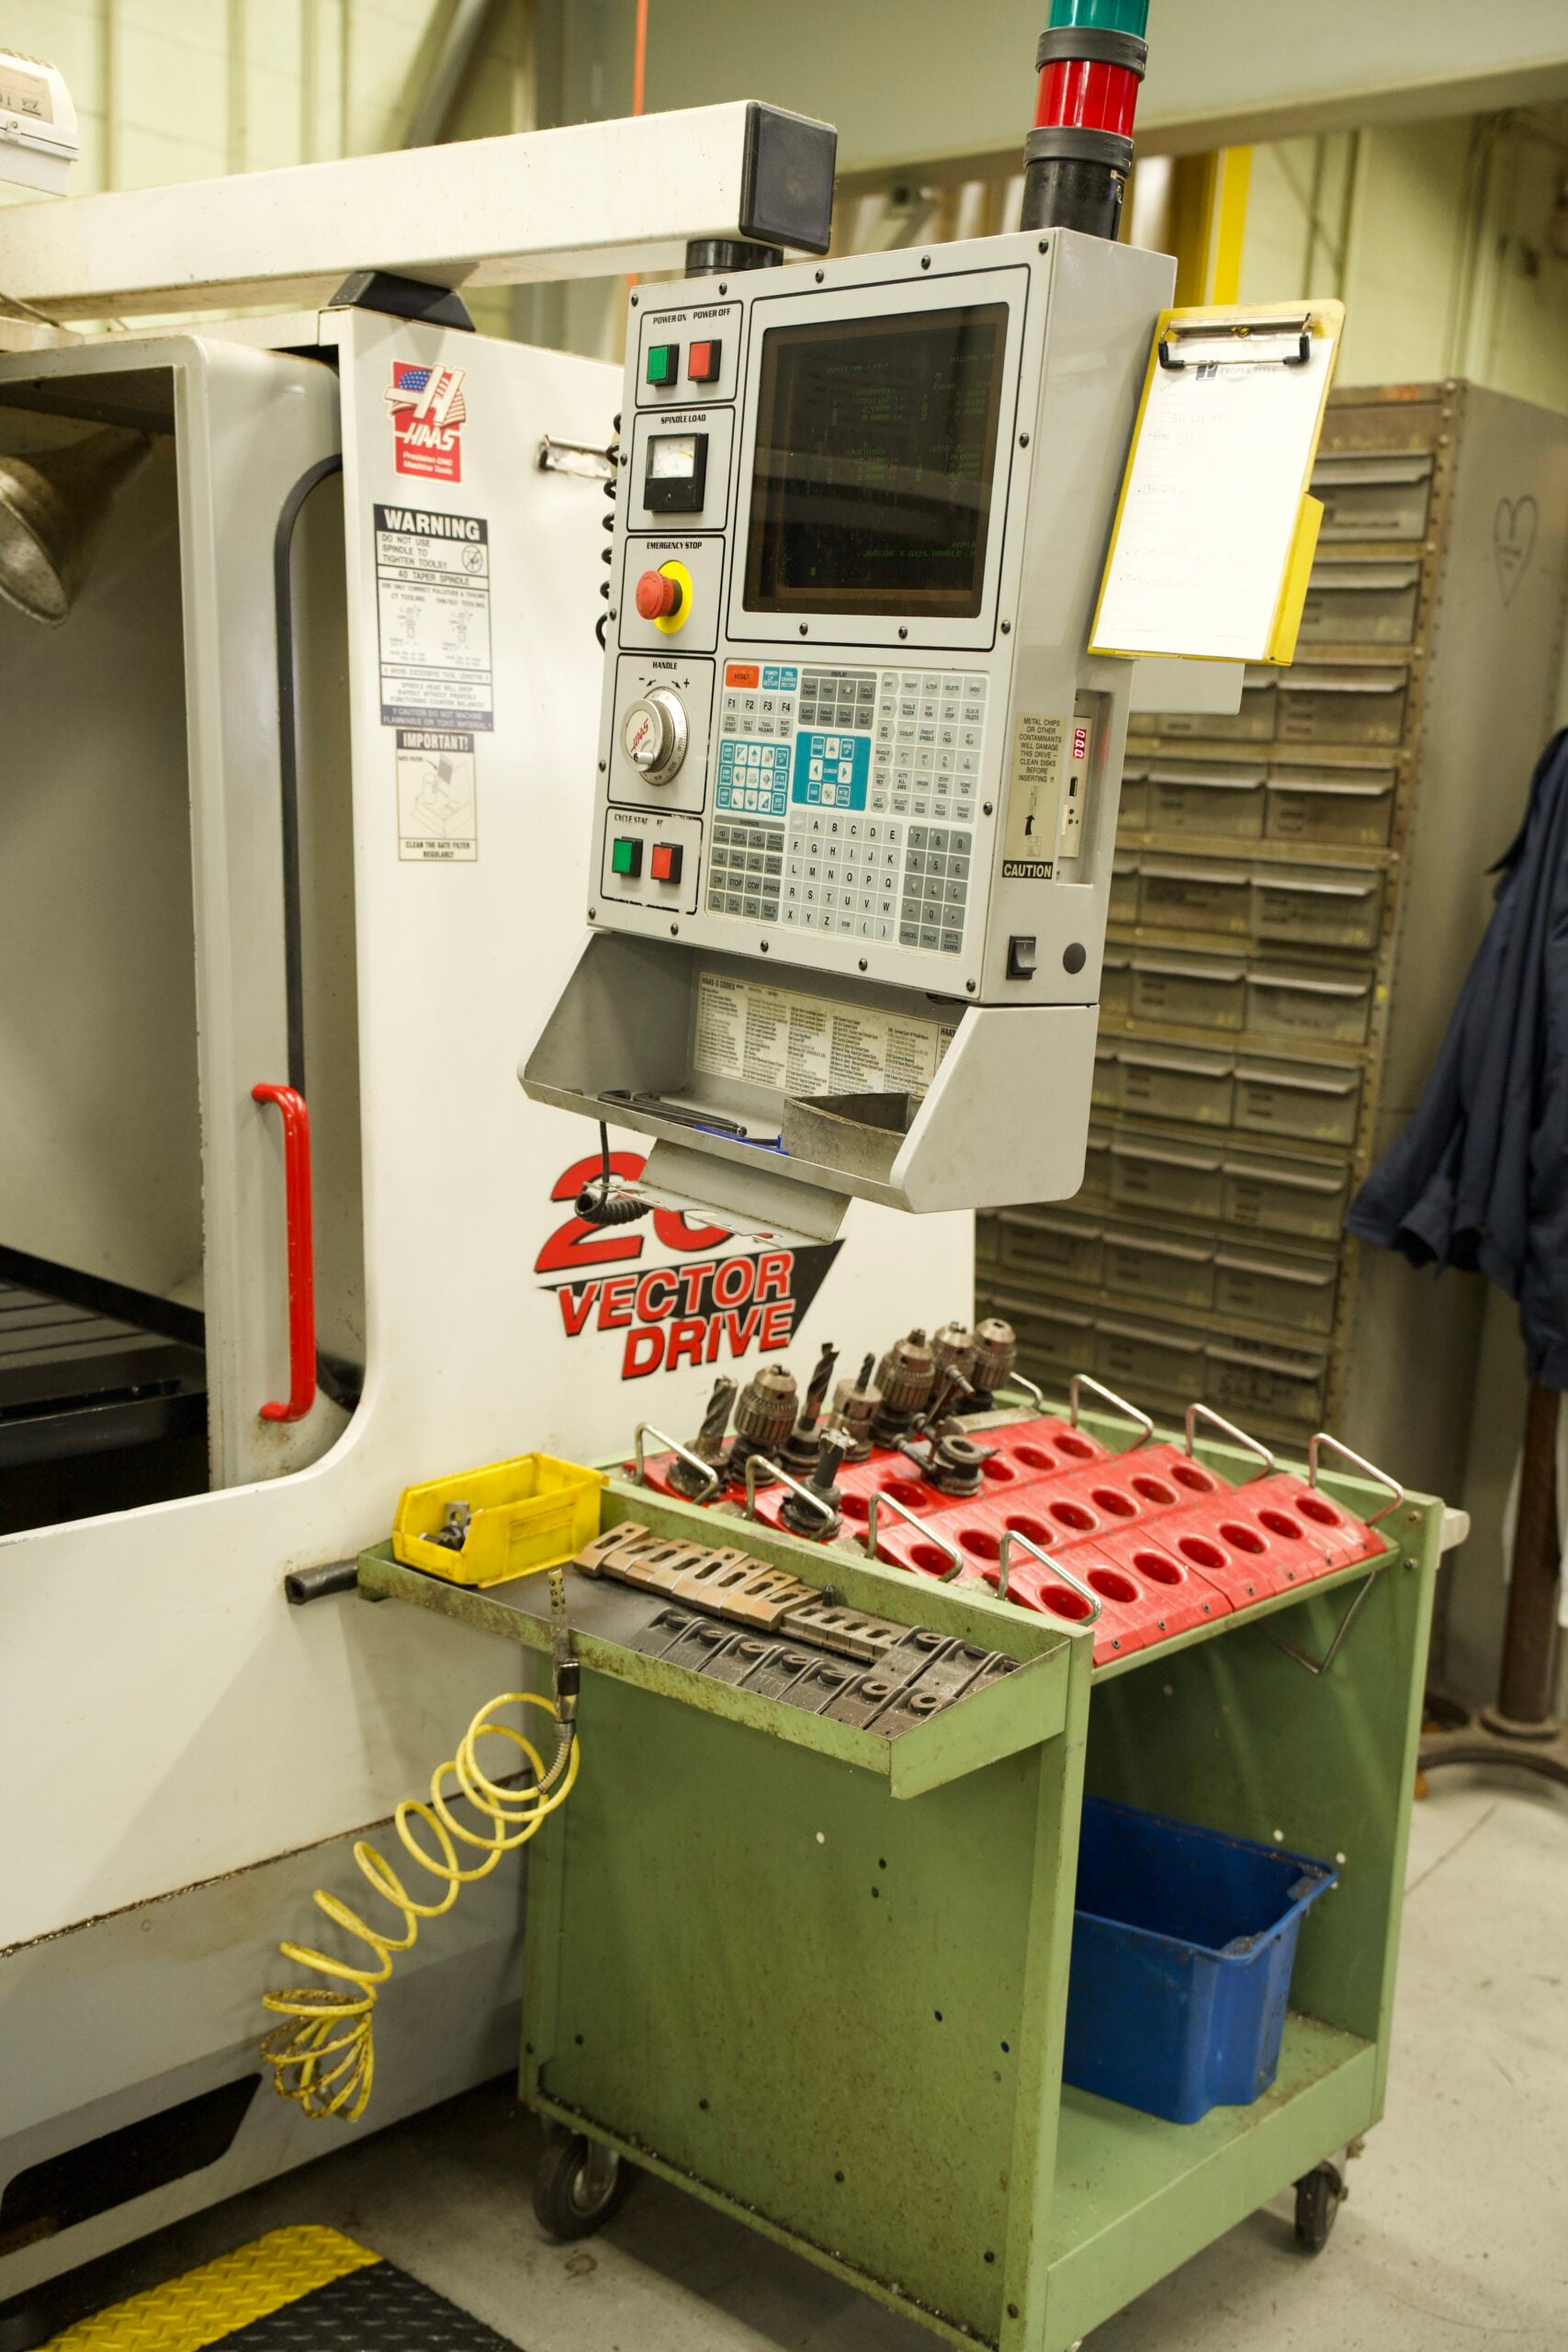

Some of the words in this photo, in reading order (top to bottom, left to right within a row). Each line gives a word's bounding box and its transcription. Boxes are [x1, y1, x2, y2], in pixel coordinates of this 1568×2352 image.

[694, 310, 717, 320] POWER
[718, 308, 731, 316] OFF
[653, 315, 676, 324] POWER
[661, 415, 688, 424] SPINDLE
[396, 423, 455, 451] HAAS
[437, 457, 453, 467] CNC
[384, 509, 480, 541] WARNING
[381, 534, 392, 542] DO
[415, 538, 430, 548] USE
[382, 544, 413, 555] SPINDLE
[418, 548, 428, 557] TO
[383, 555, 414, 565] TIGHTEN
[412, 571, 435, 581] TAPER
[439, 575, 470, 586] SPINDLE
[652, 662, 678, 670] HANDLE
[728, 698, 735, 707] F1
[745, 700, 754, 709] F2
[763, 701, 772, 711] F3
[782, 703, 790, 712] F4
[1023, 718, 1042, 726] METAL
[1043, 718, 1060, 727] CHIPS
[403, 732, 468, 751] IMPORTANT!
[1019, 734, 1062, 743] CONTAMINANTS
[1021, 750, 1034, 758] THIS
[1020, 758, 1039, 766] CLEAN
[1026, 766, 1048, 775] BEFORE
[1019, 775, 1047, 783] INSERTING
[813, 821, 818, 830] A
[832, 823, 838, 832] B
[852, 825, 856, 834] C
[871, 828, 875, 837] D
[890, 831, 895, 840] E
[915, 833, 920, 843] 7
[936, 836, 941, 845] 8
[406, 841, 423, 849] CLEAN
[794, 842, 798, 850] F
[957, 839, 963, 848] 9
[812, 844, 817, 854] G
[830, 846, 835, 856] H
[869, 853, 874, 861] J
[887, 854, 893, 864] K
[912, 858, 918, 867] 4
[933, 861, 939, 870] 5
[792, 865, 795, 874] L
[810, 867, 816, 876] M
[955, 864, 960, 873] 6
[1004, 864, 1053, 878] CAUTION
[829, 870, 833, 879] N
[847, 873, 852, 882] O
[729, 877, 742, 886] STOP
[866, 876, 871, 885] P
[886, 878, 891, 888] Q
[763, 884, 780, 892] SPINDLE
[790, 888, 795, 897] R
[808, 890, 813, 899] S
[827, 893, 831, 901] T
[845, 896, 851, 905] U
[864, 899, 869, 909] V
[883, 902, 890, 911] W
[788, 910, 793, 919] X
[807, 913, 811, 922] Y
[929, 910, 934, 919] 0
[824, 917, 829, 925] Z
[901, 930, 918, 939] CANCEL
[923, 933, 936, 942] SPACE
[557, 1249, 794, 1338] VECTOR
[621, 1298, 795, 1381] DRIVE
